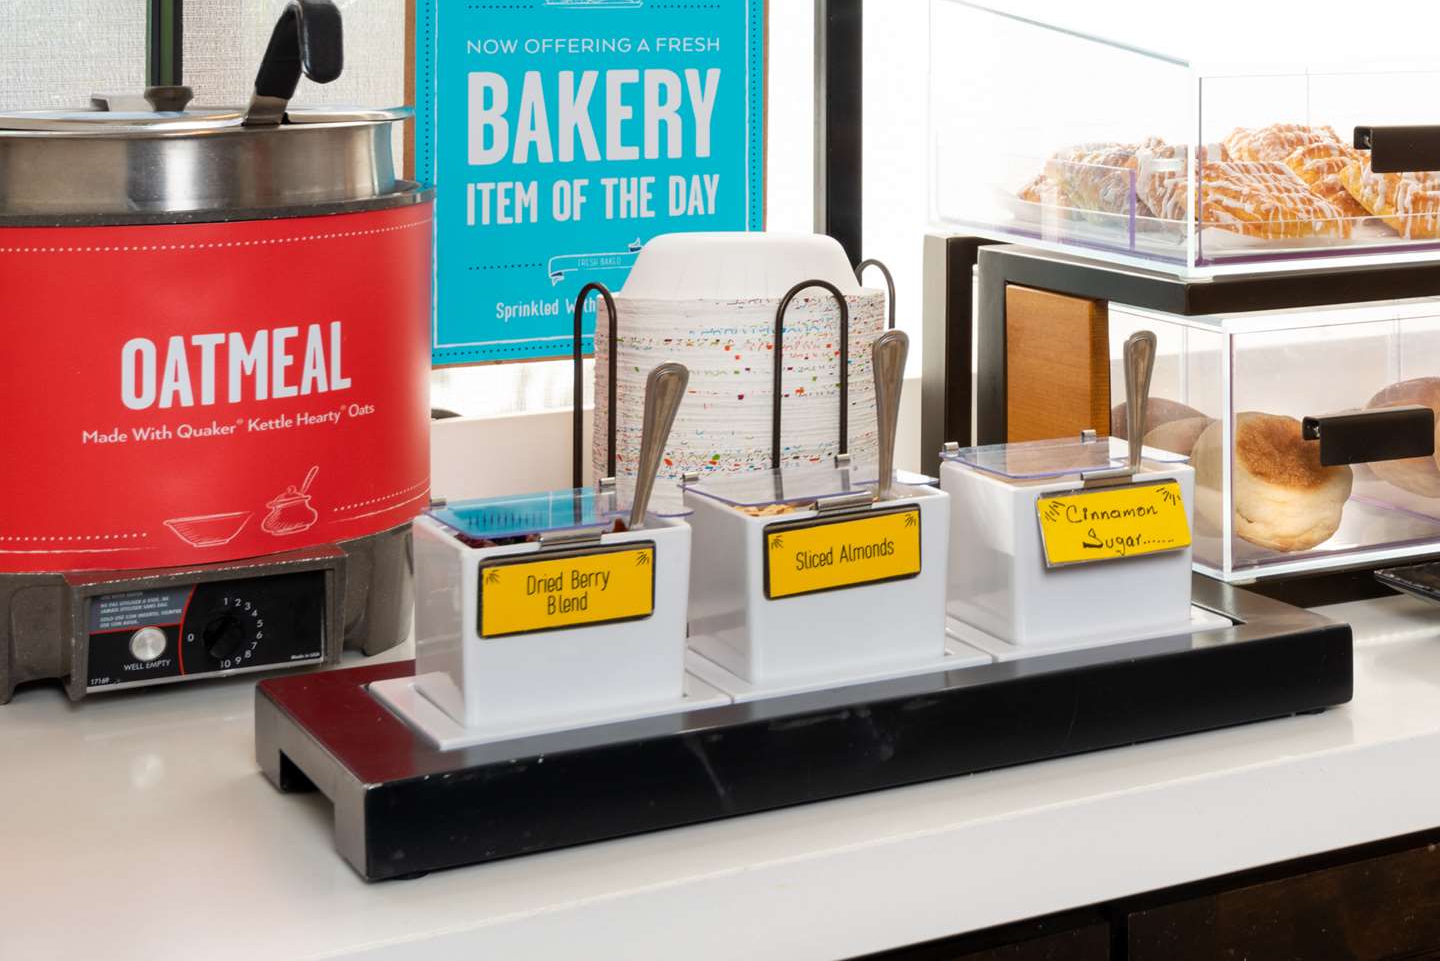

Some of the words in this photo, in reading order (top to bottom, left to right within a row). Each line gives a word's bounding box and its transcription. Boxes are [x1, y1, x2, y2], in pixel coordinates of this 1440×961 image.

[467, 38, 519, 56] NOW
[524, 37, 632, 55] OFFERING
[637, 37, 650, 53] A
[655, 36, 720, 53] FRESH
[467, 67, 721, 166] BAKERY
[466, 181, 539, 226] ITEM
[552, 178, 589, 222] OF
[600, 176, 655, 219] THE
[669, 174, 720, 216] DAY
[496, 298, 559, 323] Sprinkled
[566, 297, 596, 316] Wth
[121, 321, 352, 410] OATMEAL
[82, 430, 128, 444] Made
[132, 426, 172, 441] With
[248, 413, 293, 432] Kettle
[348, 403, 375, 418] Oats
[1065, 503, 1158, 524] Cinnamon
[795, 546, 833, 571] Sliced
[838, 537, 895, 564] Almonds
[526, 570, 564, 596] Dried
[571, 569, 611, 592] Berry
[224, 597, 228, 606] 1
[234, 599, 241, 607] 2
[244, 602, 251, 610] 3
[547, 594, 589, 616] Blend
[251, 609, 258, 617] 4
[257, 619, 263, 628] 5
[256, 631, 263, 639] 6
[251, 641, 258, 650] 7
[235, 657, 242, 665] 9
[244, 650, 252, 658] 8
[124, 663, 144, 671] WELL
[146, 659, 171, 669] EMPTY
